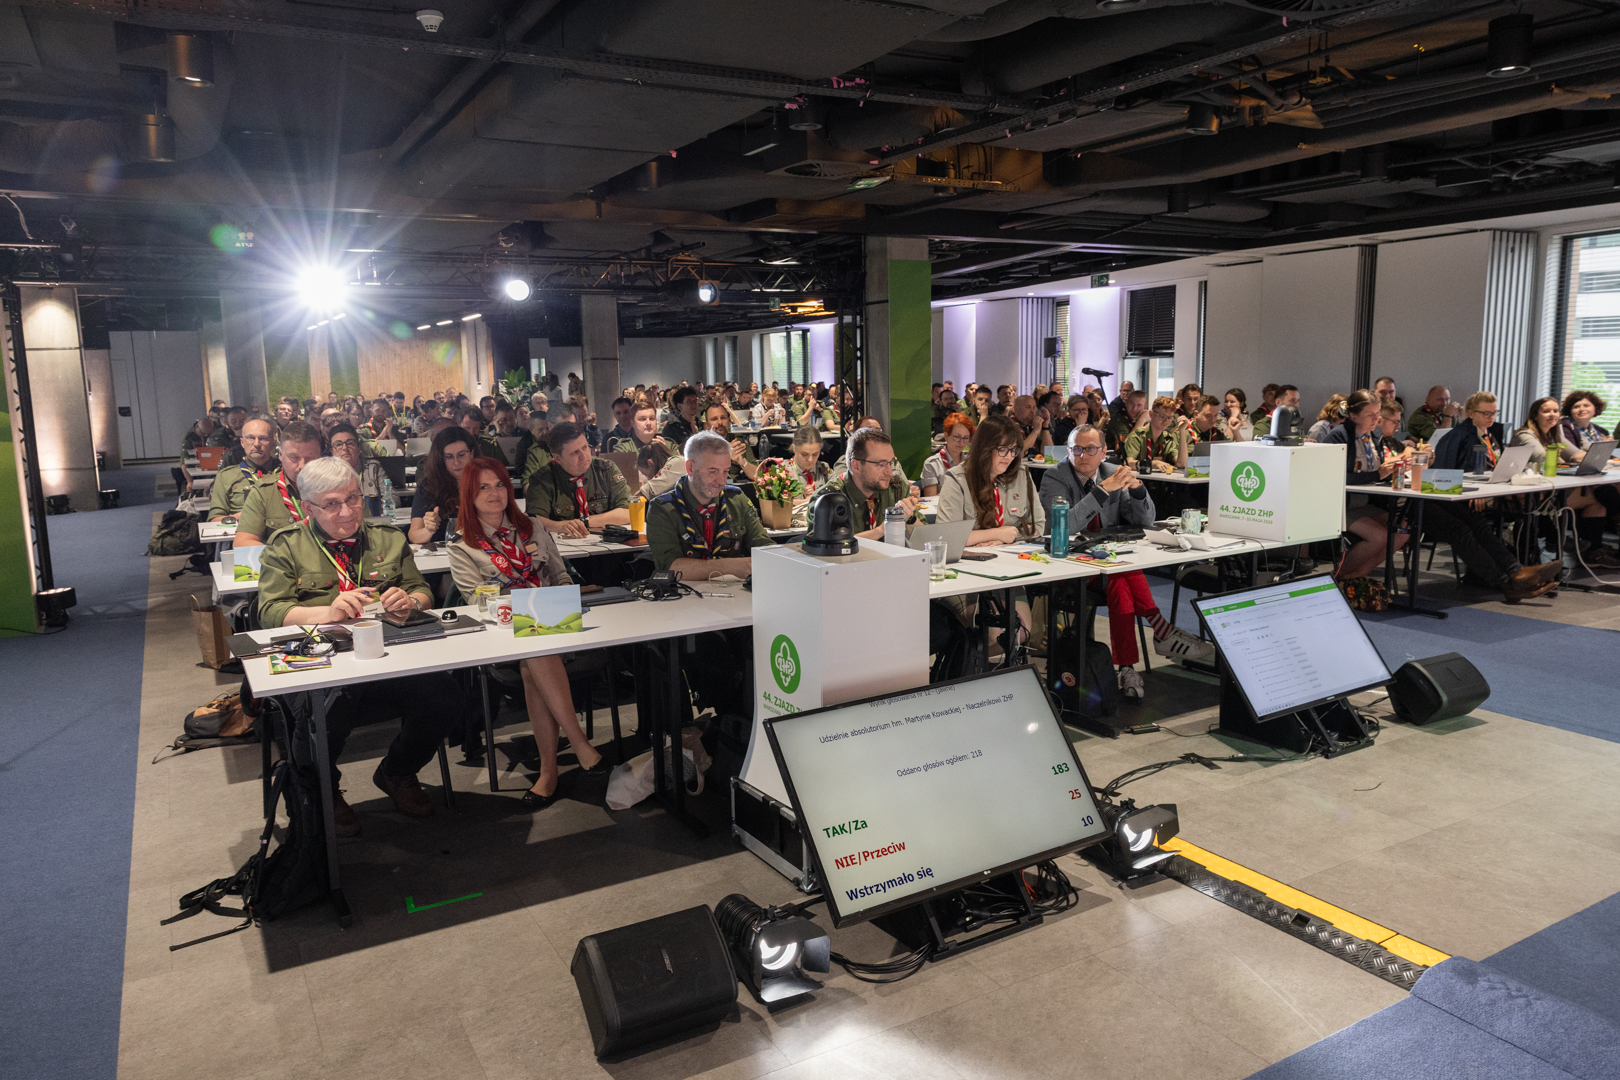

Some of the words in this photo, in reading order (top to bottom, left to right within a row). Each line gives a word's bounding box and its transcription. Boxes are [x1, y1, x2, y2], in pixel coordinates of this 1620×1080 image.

[1219, 504, 1231, 513] 44.
[1232, 506, 1257, 516] ZJAZD
[1257, 509, 1274, 518] ZHP
[763, 691, 773, 704] 44.
[774, 695, 796, 714] ZJAZD
[819, 731, 850, 744] Udzielnie
[850, 723, 891, 737] absolutorium
[904, 713, 931, 724] Martynie
[931, 706, 962, 718] Kowackiej
[965, 697, 1002, 711] Naczelnikowi
[1002, 693, 1014, 703] ZHP
[897, 766, 922, 777] Oddano
[922, 760, 945, 772] głosów
[945, 754, 970, 765] ogółem:
[970, 749, 983, 758] 218
[1051, 762, 1070, 775] 183
[1068, 788, 1082, 800] 25
[822, 820, 868, 838] TAK/Za
[1081, 816, 1094, 826] 10
[834, 842, 906, 870] NIE/Przeciw
[845, 872, 915, 901] Wstrzymało
[916, 866, 934, 880] się
